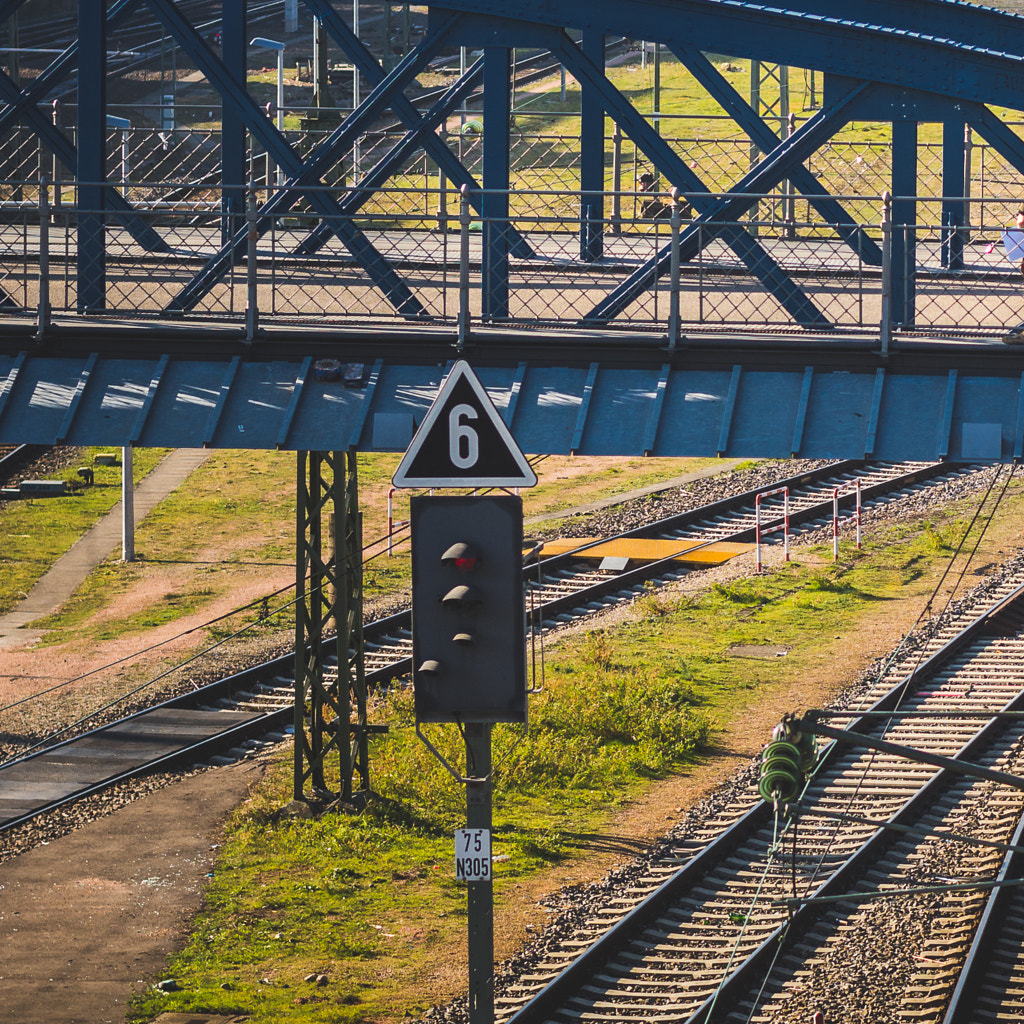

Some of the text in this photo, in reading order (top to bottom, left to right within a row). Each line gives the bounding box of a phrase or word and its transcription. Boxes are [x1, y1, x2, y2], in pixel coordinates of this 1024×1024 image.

[449, 403, 479, 469] 6
[463, 833, 482, 852] 75
[456, 858, 489, 877] N305
